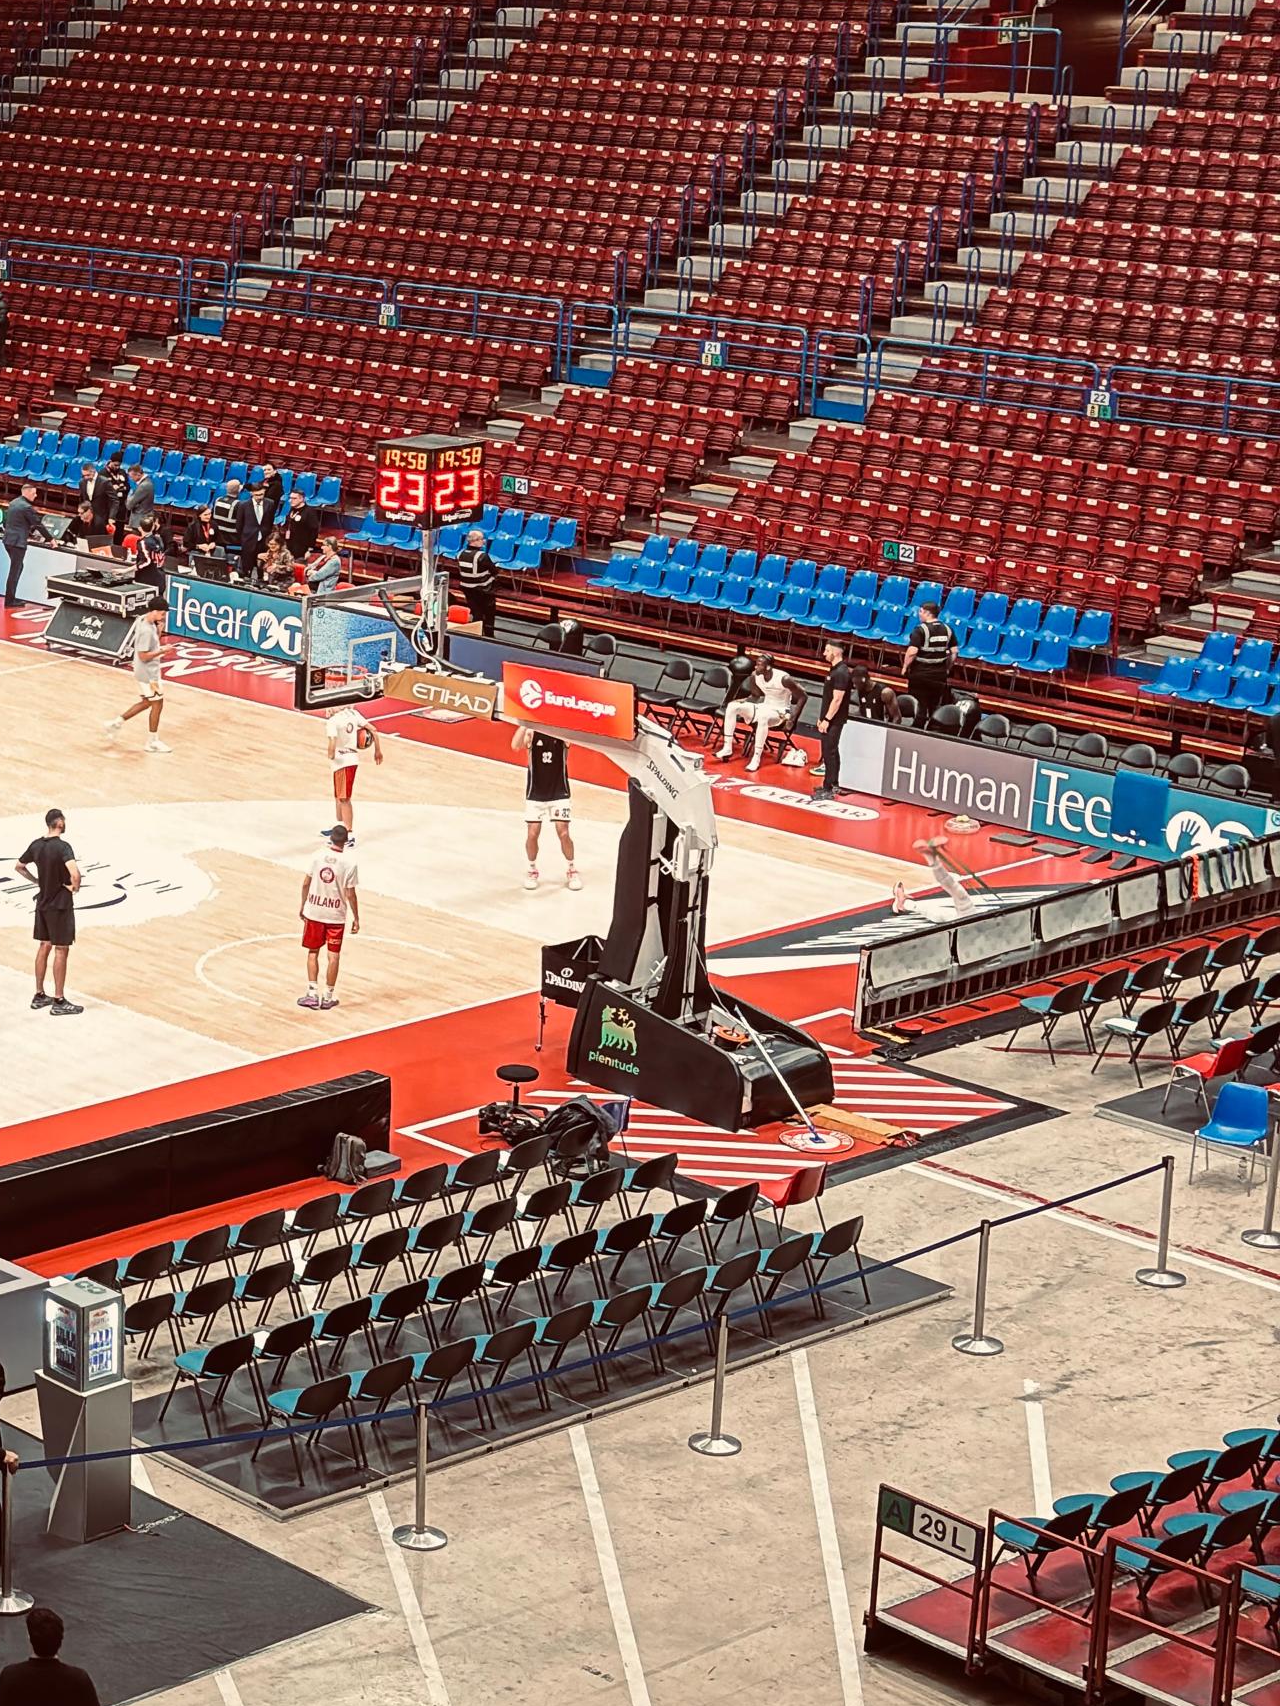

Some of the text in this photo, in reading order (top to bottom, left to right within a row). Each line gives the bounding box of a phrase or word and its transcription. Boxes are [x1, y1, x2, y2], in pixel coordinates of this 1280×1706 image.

[382, 305, 393, 314] 20
[706, 343, 719, 352] 21
[1093, 394, 1107, 404] 22
[198, 429, 207, 440] 20
[385, 446, 482, 471] 19:58 19:58
[379, 469, 480, 512] 23 23
[516, 481, 527, 491] 21
[900, 548, 913, 559] 22
[171, 581, 249, 641] Tecar
[412, 683, 492, 714] ETIHAD
[544, 691, 616, 719] EuroLeague
[646, 760, 678, 799] SPALDING
[892, 748, 1021, 819] Human
[308, 893, 341, 909] MILANO
[545, 969, 586, 994] SPALDIN
[588, 1049, 640, 1076] plenitude
[886, 1499, 966, 1553] A 29 L
